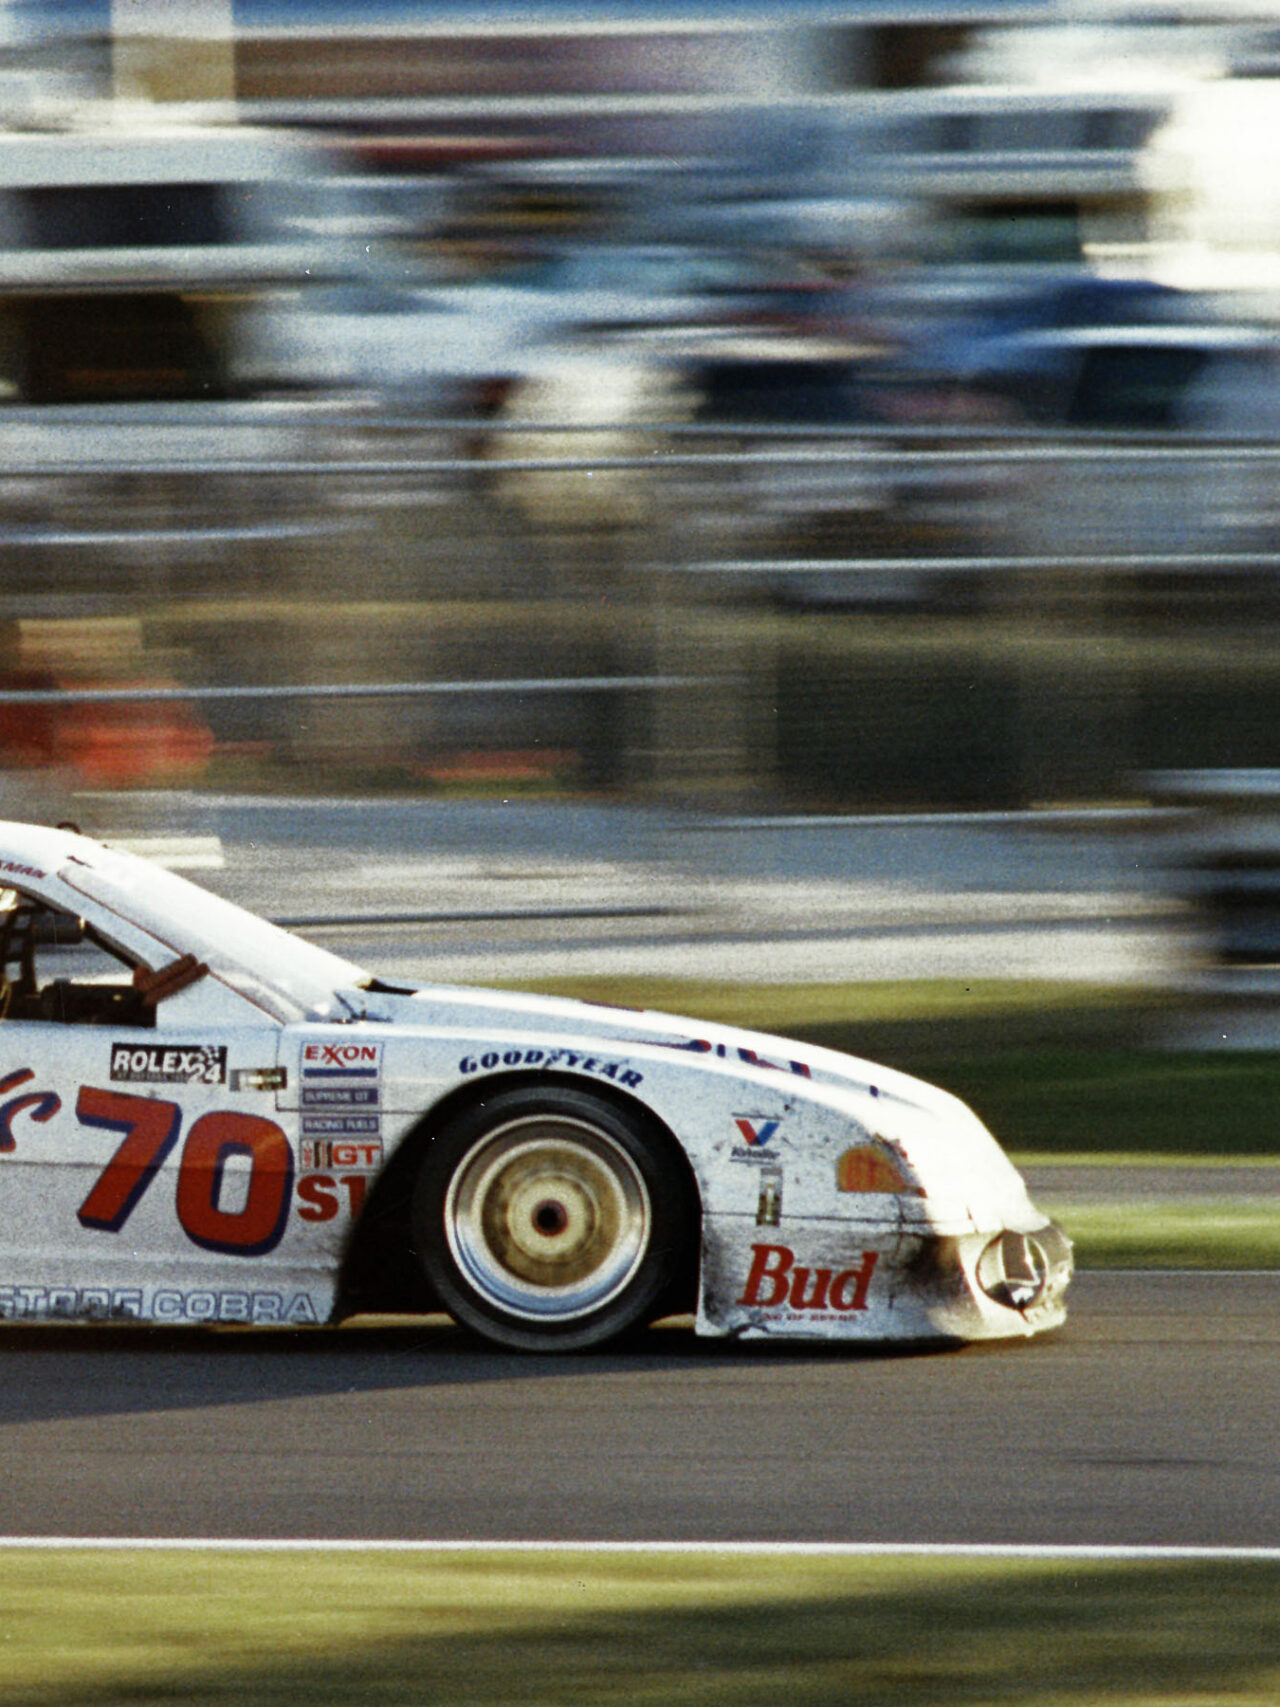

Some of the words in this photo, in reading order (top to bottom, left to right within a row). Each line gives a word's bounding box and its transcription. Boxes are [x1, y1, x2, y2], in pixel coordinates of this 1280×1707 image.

[113, 1050, 191, 1073] ROLEX
[305, 1044, 376, 1068] EXXON
[458, 1050, 643, 1089] GOODYEAR
[75, 1085, 295, 1257] 70
[333, 1145, 380, 1165] GT
[735, 1243, 879, 1311] Bud
[153, 1288, 319, 1325] COBRA
